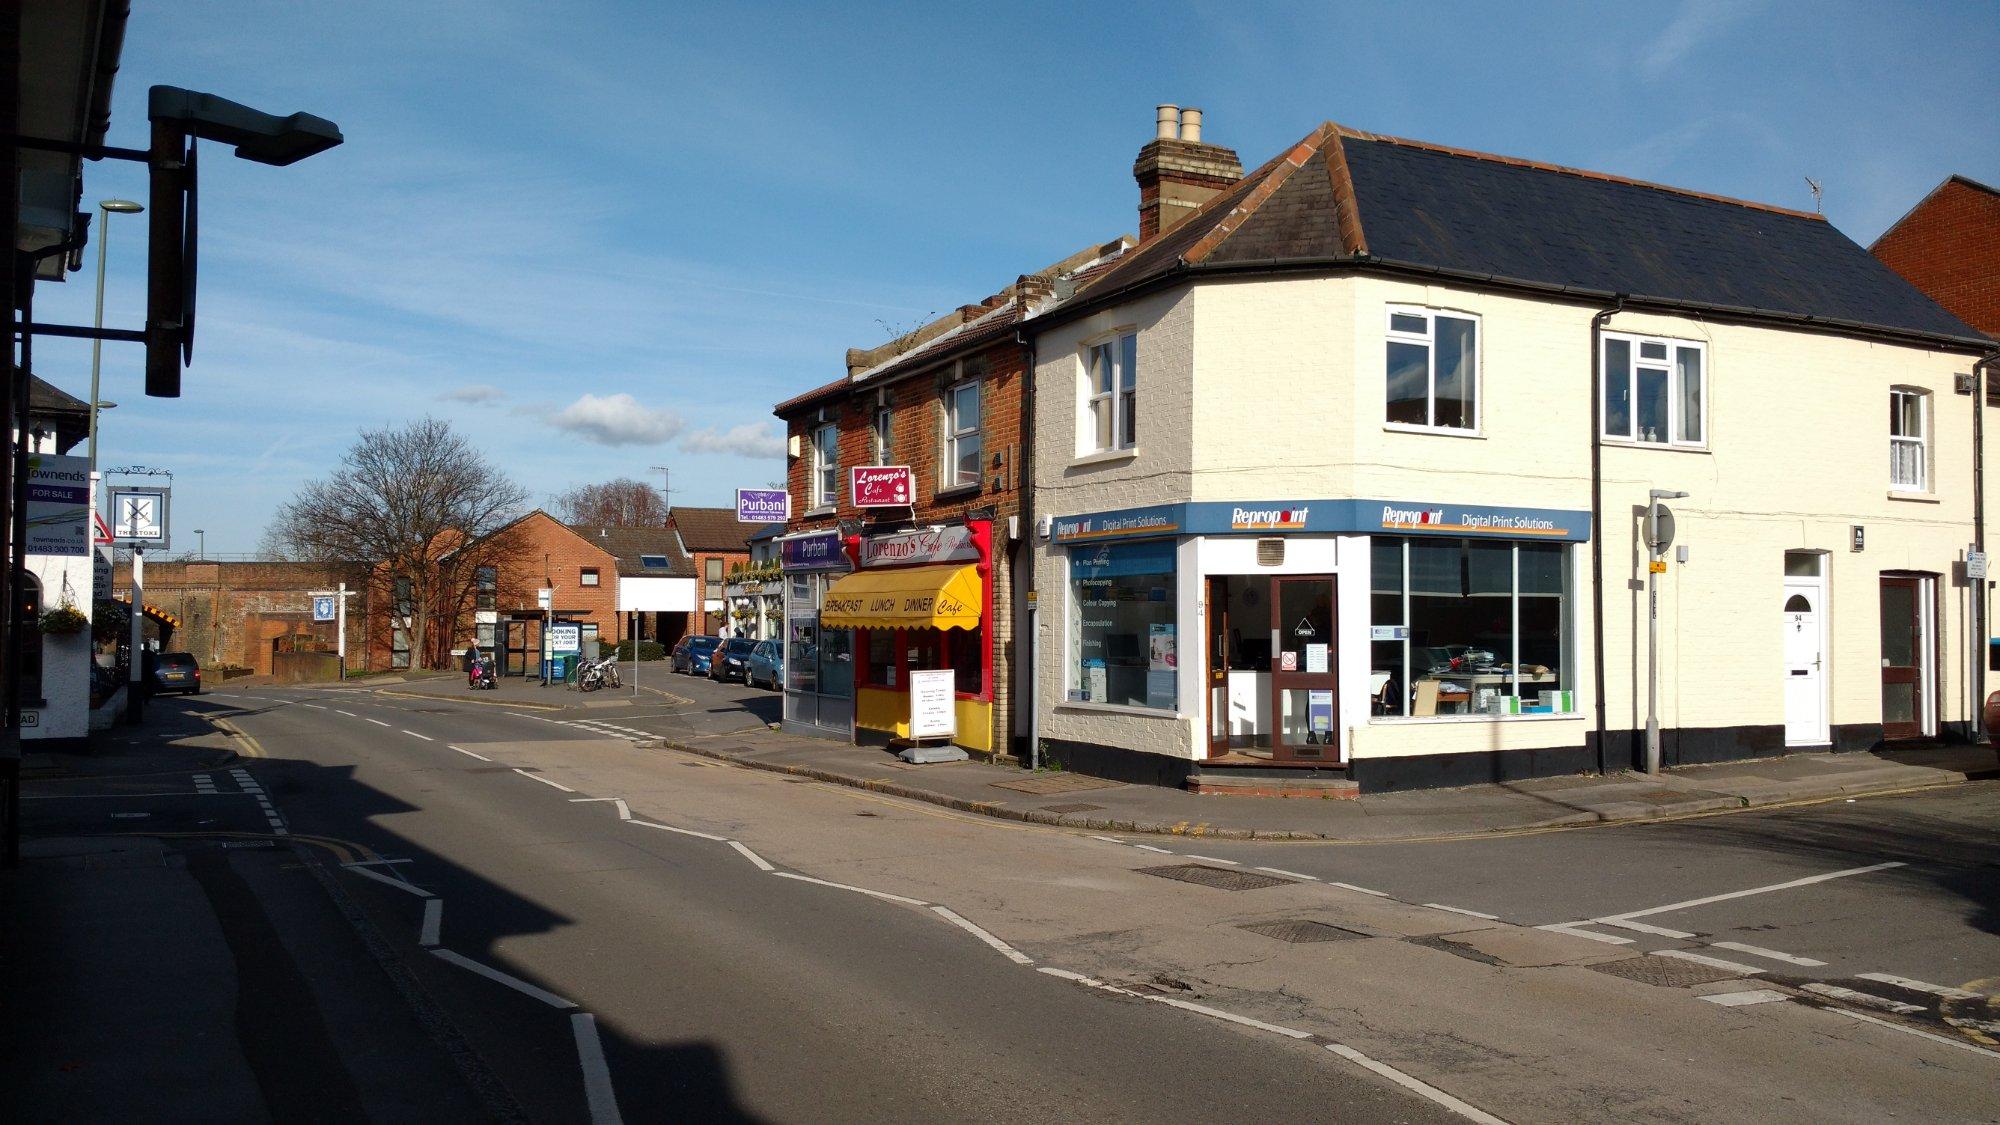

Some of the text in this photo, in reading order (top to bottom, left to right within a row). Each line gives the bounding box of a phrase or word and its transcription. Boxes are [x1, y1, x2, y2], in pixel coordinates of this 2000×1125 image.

[28, 466, 86, 482] Townends
[856, 468, 906, 484] Lorenzo's
[32, 489, 73, 499] FOR SALE
[741, 498, 785, 511] Purbani
[1232, 507, 1309, 529] Repropoint
[1382, 506, 1554, 530] Repropoint Digital Print Solutions
[1057, 515, 1167, 538] Repropoint Digital Print Solutions
[33, 536, 84, 544] townends.co.uk
[802, 537, 828, 557] Purbani
[866, 536, 916, 559] Lorenzo's
[28, 545, 53, 553] 01483
[54, 545, 69, 553] 300
[1093, 558, 1110, 567] Printing
[825, 597, 963, 616] BREAKFAST LUNCH DINNER Cafe
[1099, 600, 1117, 608] Copying
